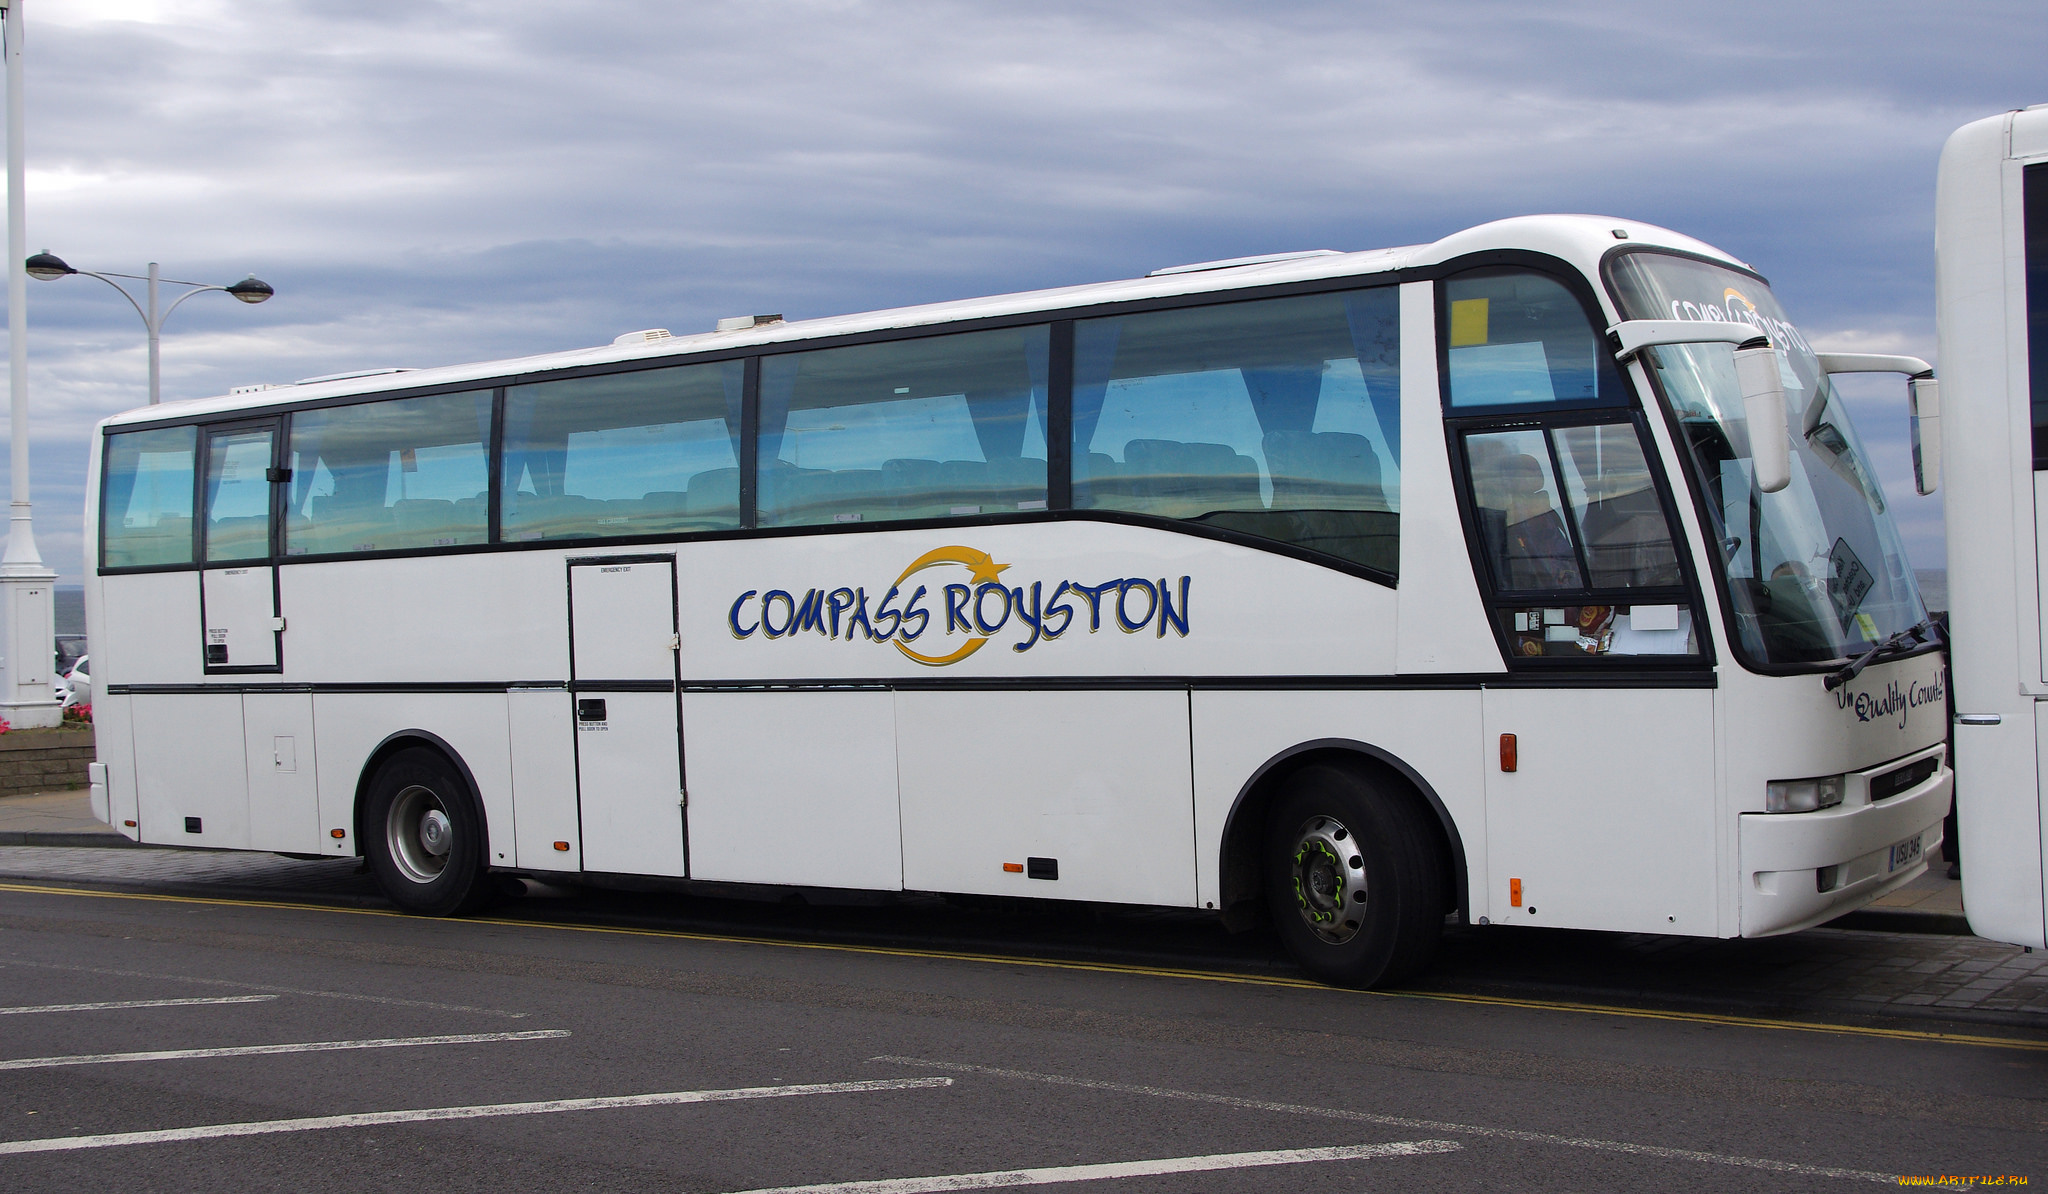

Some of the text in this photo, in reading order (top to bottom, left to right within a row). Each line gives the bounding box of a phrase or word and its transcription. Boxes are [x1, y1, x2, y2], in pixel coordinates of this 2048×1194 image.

[600, 566, 623, 574] EMERGENCY
[727, 575, 1191, 652] COMPASS ROYSTON
